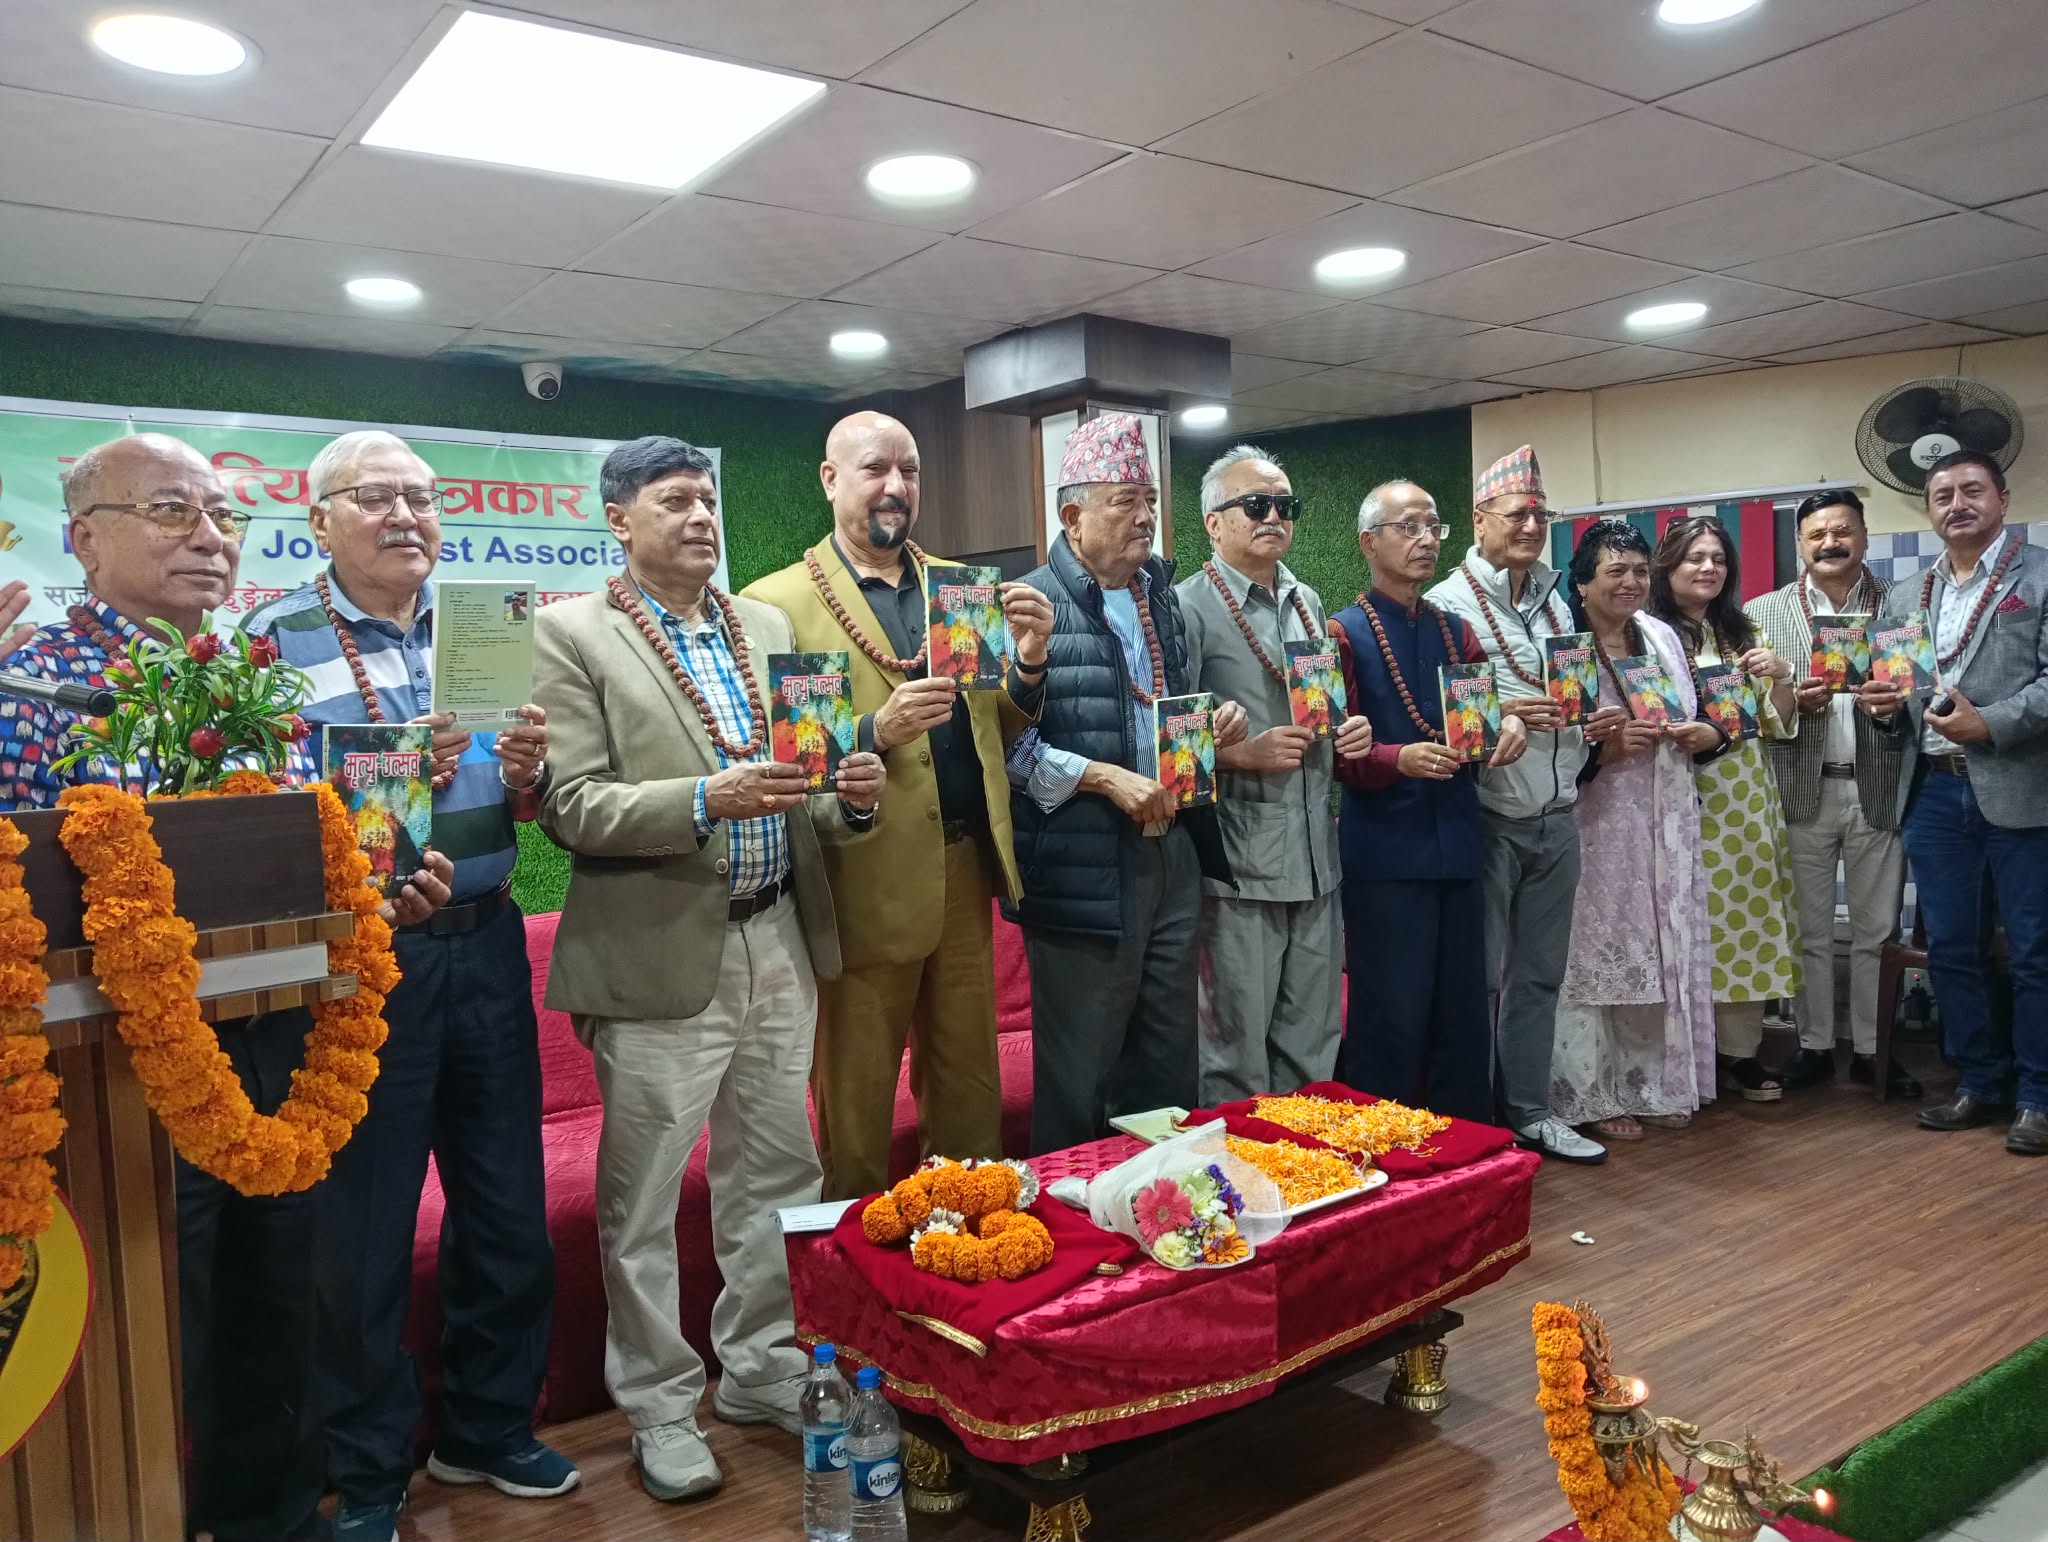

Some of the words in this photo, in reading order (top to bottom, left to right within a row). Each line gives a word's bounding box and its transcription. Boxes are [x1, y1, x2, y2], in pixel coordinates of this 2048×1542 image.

[432, 477, 590, 521] त्रकार
[484, 536, 628, 566] Associa
[829, 1446, 847, 1460] kin
